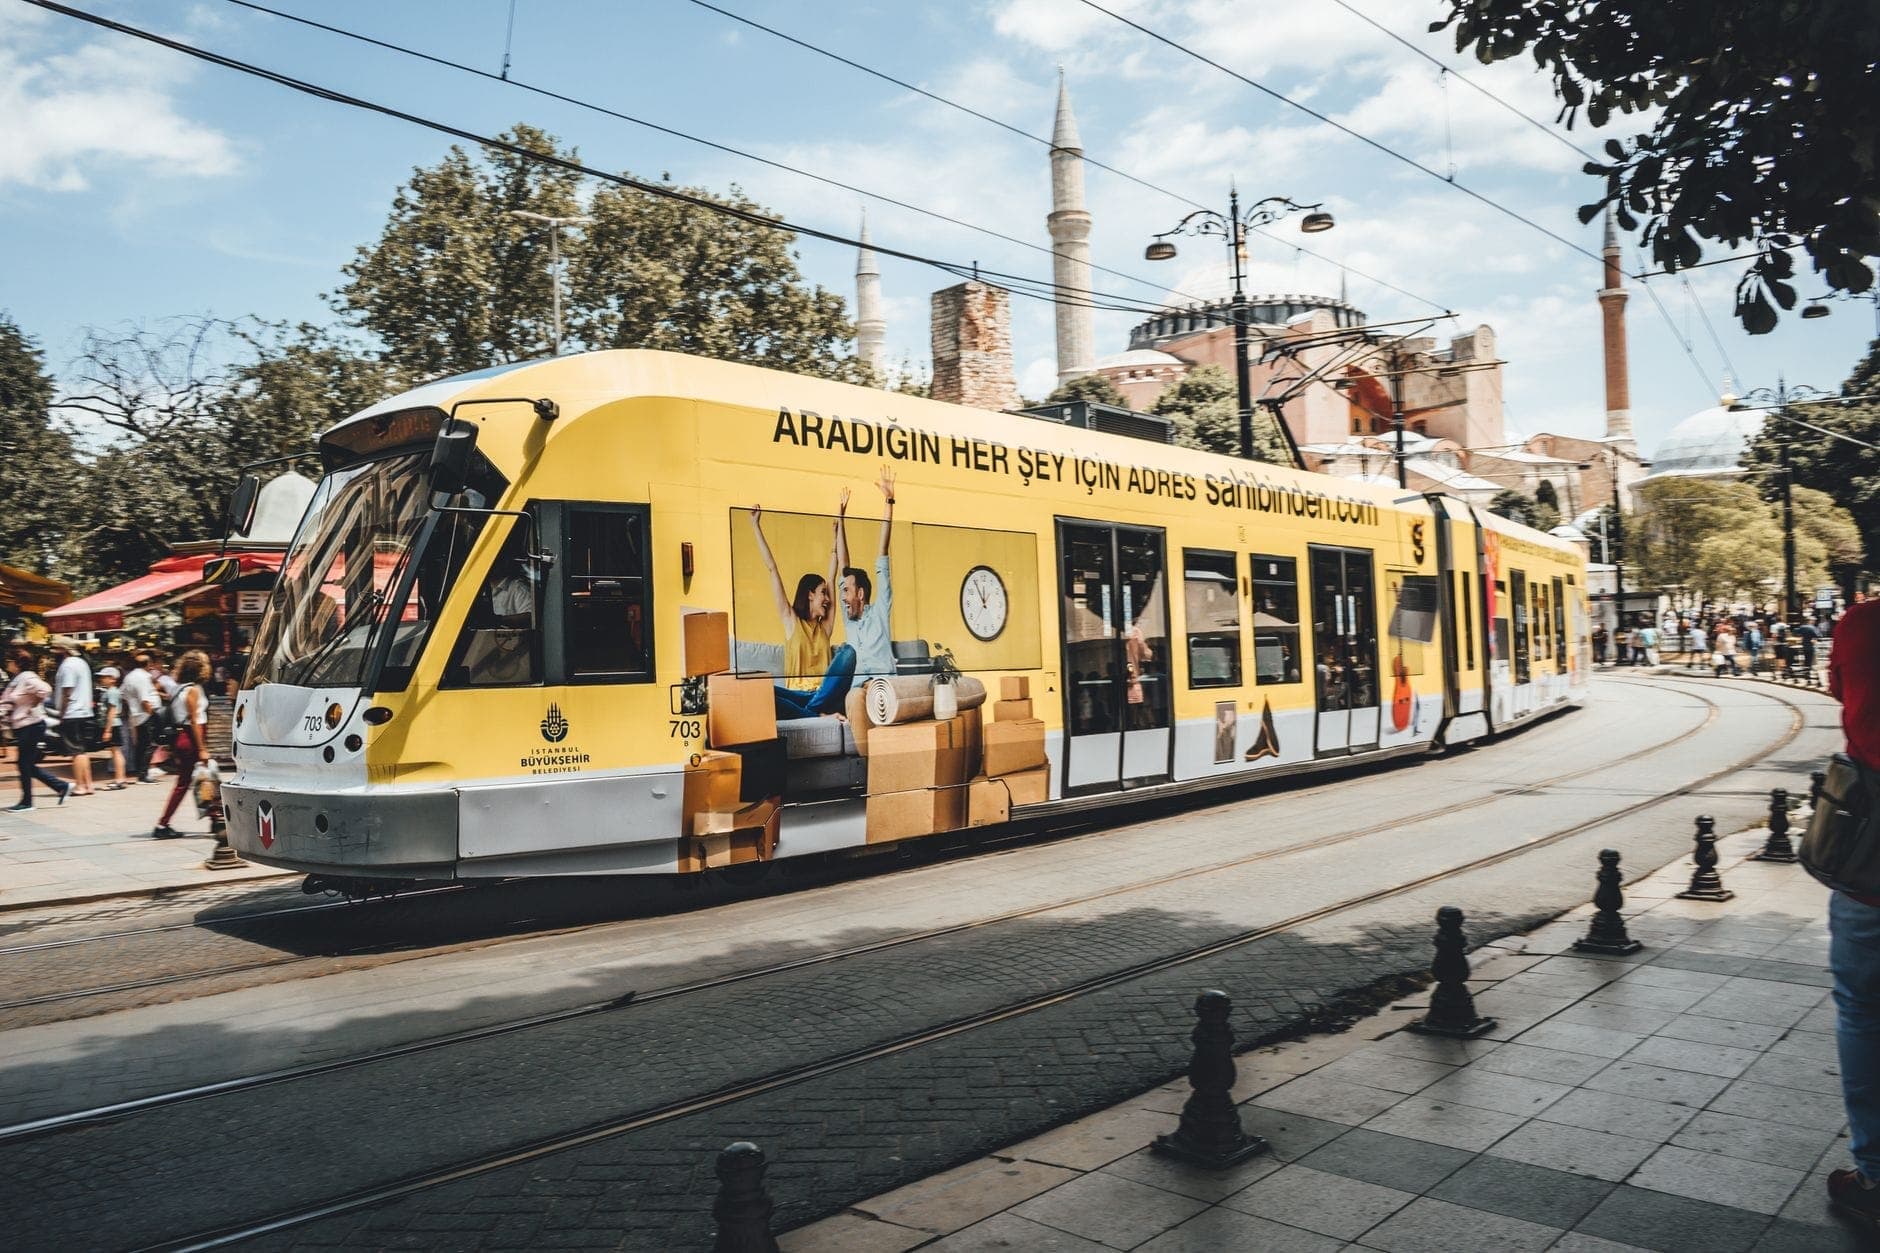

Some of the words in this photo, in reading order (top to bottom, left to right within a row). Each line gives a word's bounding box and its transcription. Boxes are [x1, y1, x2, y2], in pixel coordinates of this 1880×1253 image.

[773, 406, 940, 464] ARADIĞIN
[950, 434, 1009, 474] HER
[1018, 446, 1065, 486] ŞEY
[1071, 448, 1120, 495] İÇİN
[1127, 465, 1196, 500] ADRES
[1204, 468, 1378, 526] sahibinden.com
[304, 715, 322, 731] 703
[669, 720, 701, 738] 703
